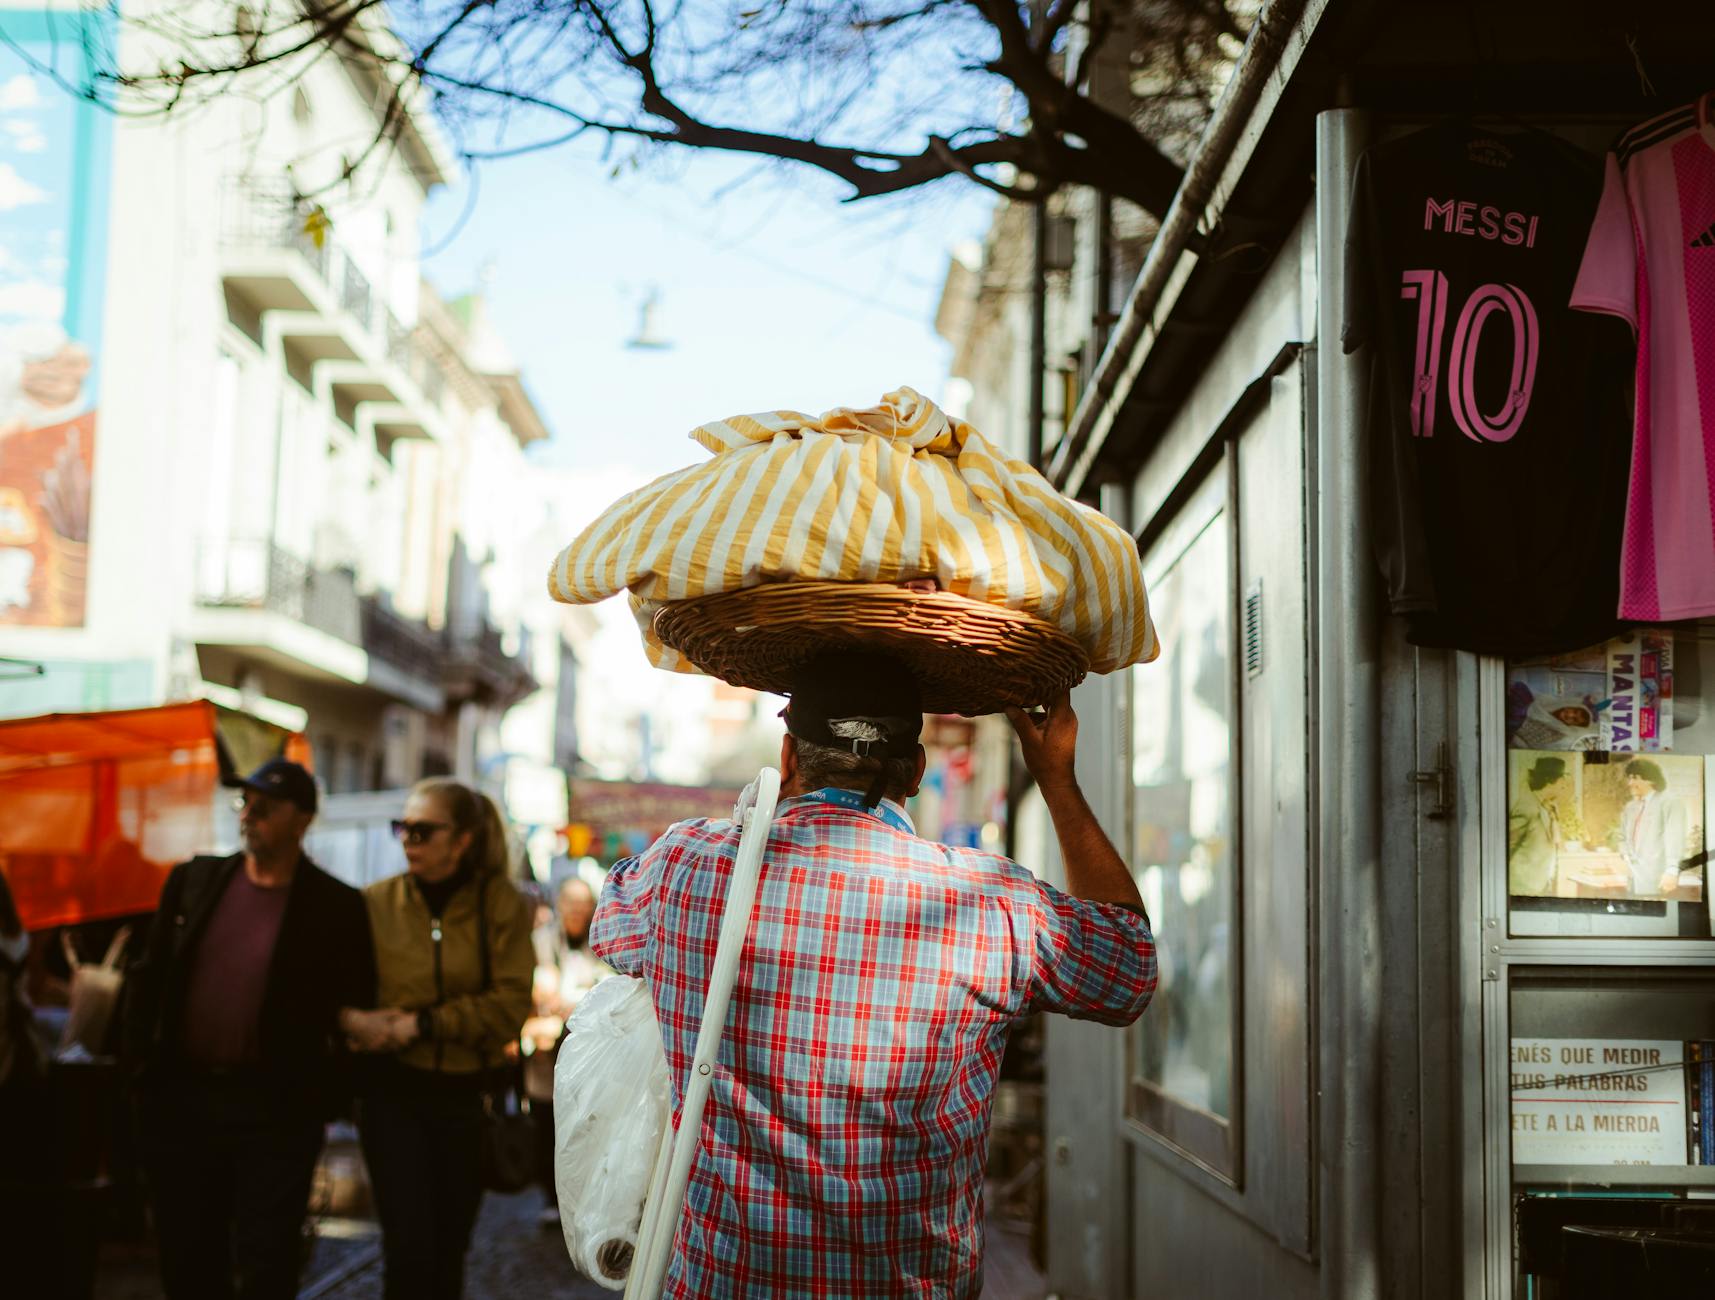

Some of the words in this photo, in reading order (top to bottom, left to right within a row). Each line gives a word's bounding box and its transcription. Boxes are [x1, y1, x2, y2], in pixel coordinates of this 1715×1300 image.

[1424, 197, 1539, 248] MESSI
[1401, 269, 1540, 443] 10
[1560, 1047, 1594, 1065] QUE
[1603, 1048, 1661, 1065] MEDIR
[1512, 1073, 1546, 1090] TUS
[1555, 1074, 1649, 1092] PALABRAS
[1546, 1114, 1558, 1132] A
[1566, 1114, 1585, 1132] LA
[1593, 1114, 1661, 1133] MIERDA
